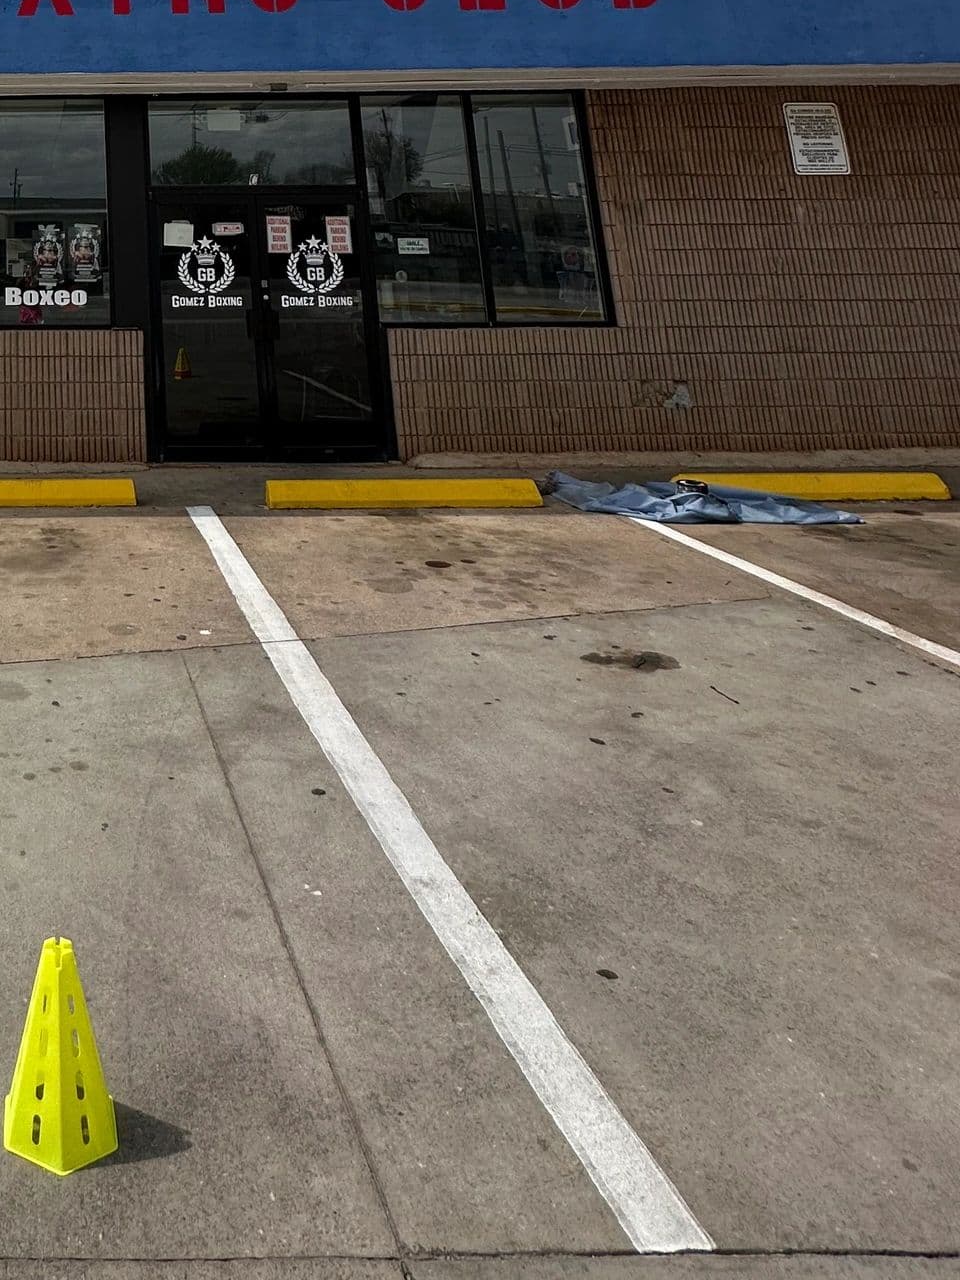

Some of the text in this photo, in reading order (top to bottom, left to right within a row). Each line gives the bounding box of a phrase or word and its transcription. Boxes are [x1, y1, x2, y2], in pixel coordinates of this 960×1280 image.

[197, 268, 216, 282] GB
[306, 267, 325, 281] GB
[4, 286, 88, 307] Boxeo
